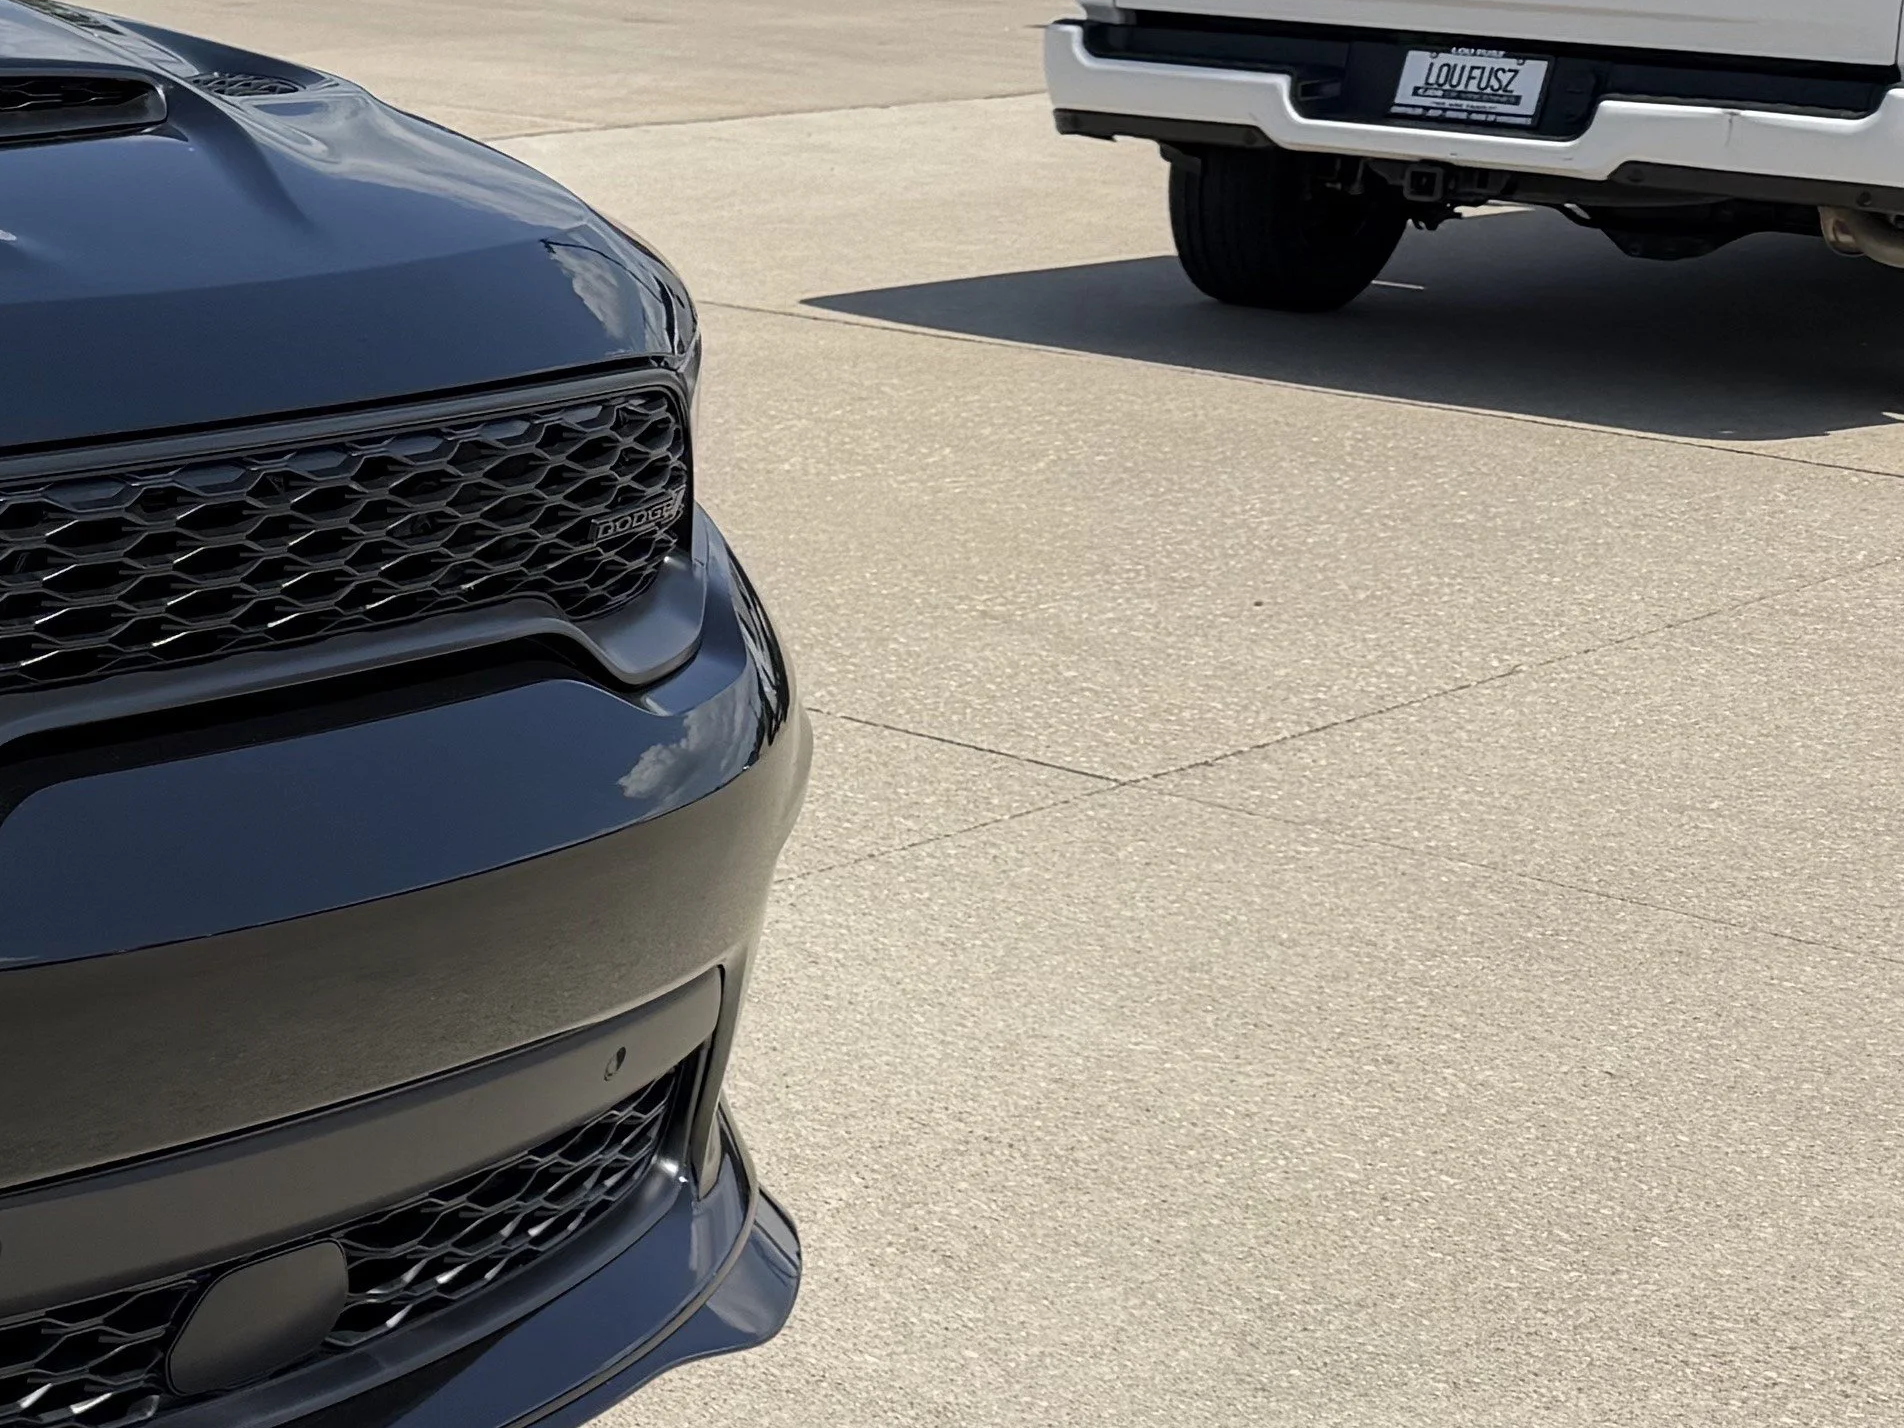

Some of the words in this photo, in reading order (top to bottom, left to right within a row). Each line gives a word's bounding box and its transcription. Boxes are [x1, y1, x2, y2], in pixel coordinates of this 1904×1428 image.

[1424, 61, 1467, 89] LOU
[1464, 65, 1521, 94] FUSZ
[597, 500, 677, 539] DODGE
